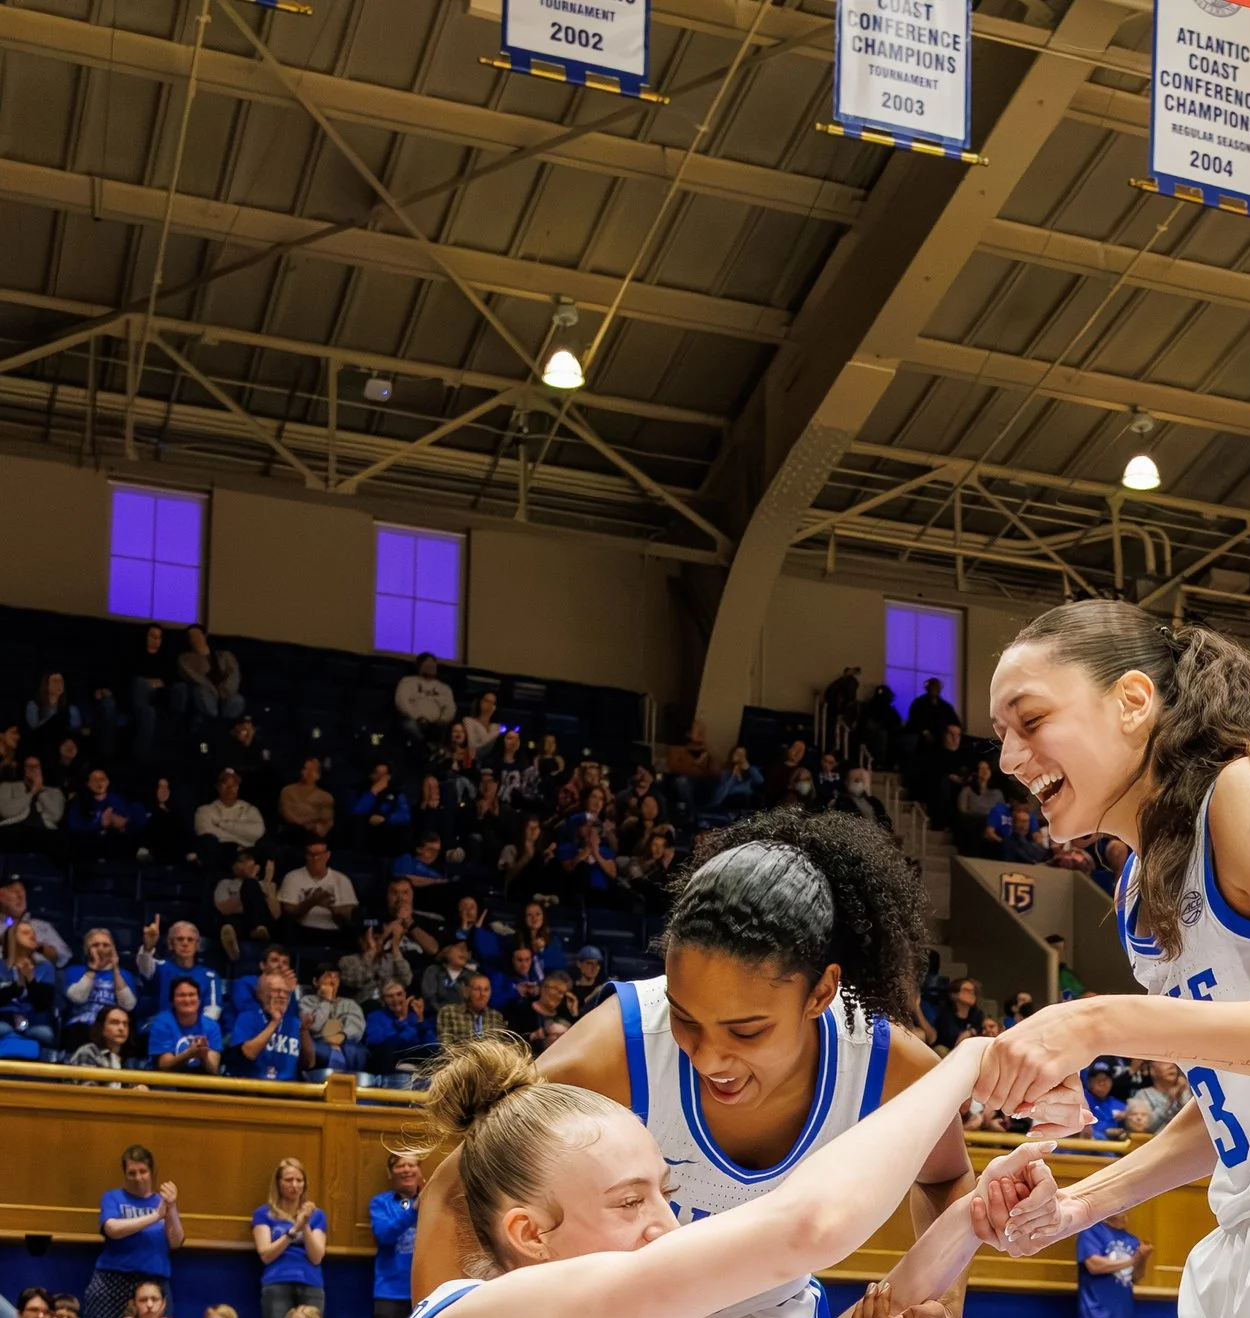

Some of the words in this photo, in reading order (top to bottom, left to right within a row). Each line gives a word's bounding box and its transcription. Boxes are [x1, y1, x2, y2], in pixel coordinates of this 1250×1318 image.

[550, 22, 604, 51] 2002
[847, 10, 961, 52] CONFERENCE
[1177, 27, 1250, 63] ATLANTIC
[852, 35, 957, 74] CHAMPIONS
[1188, 53, 1240, 82] COAST
[868, 64, 939, 90] TOURNAMENT
[881, 92, 925, 117] 2003
[1171, 123, 1214, 143] REGULAR
[1189, 150, 1234, 178] 2004
[1007, 884, 1032, 908] 15
[1187, 1066, 1250, 1169] 3
